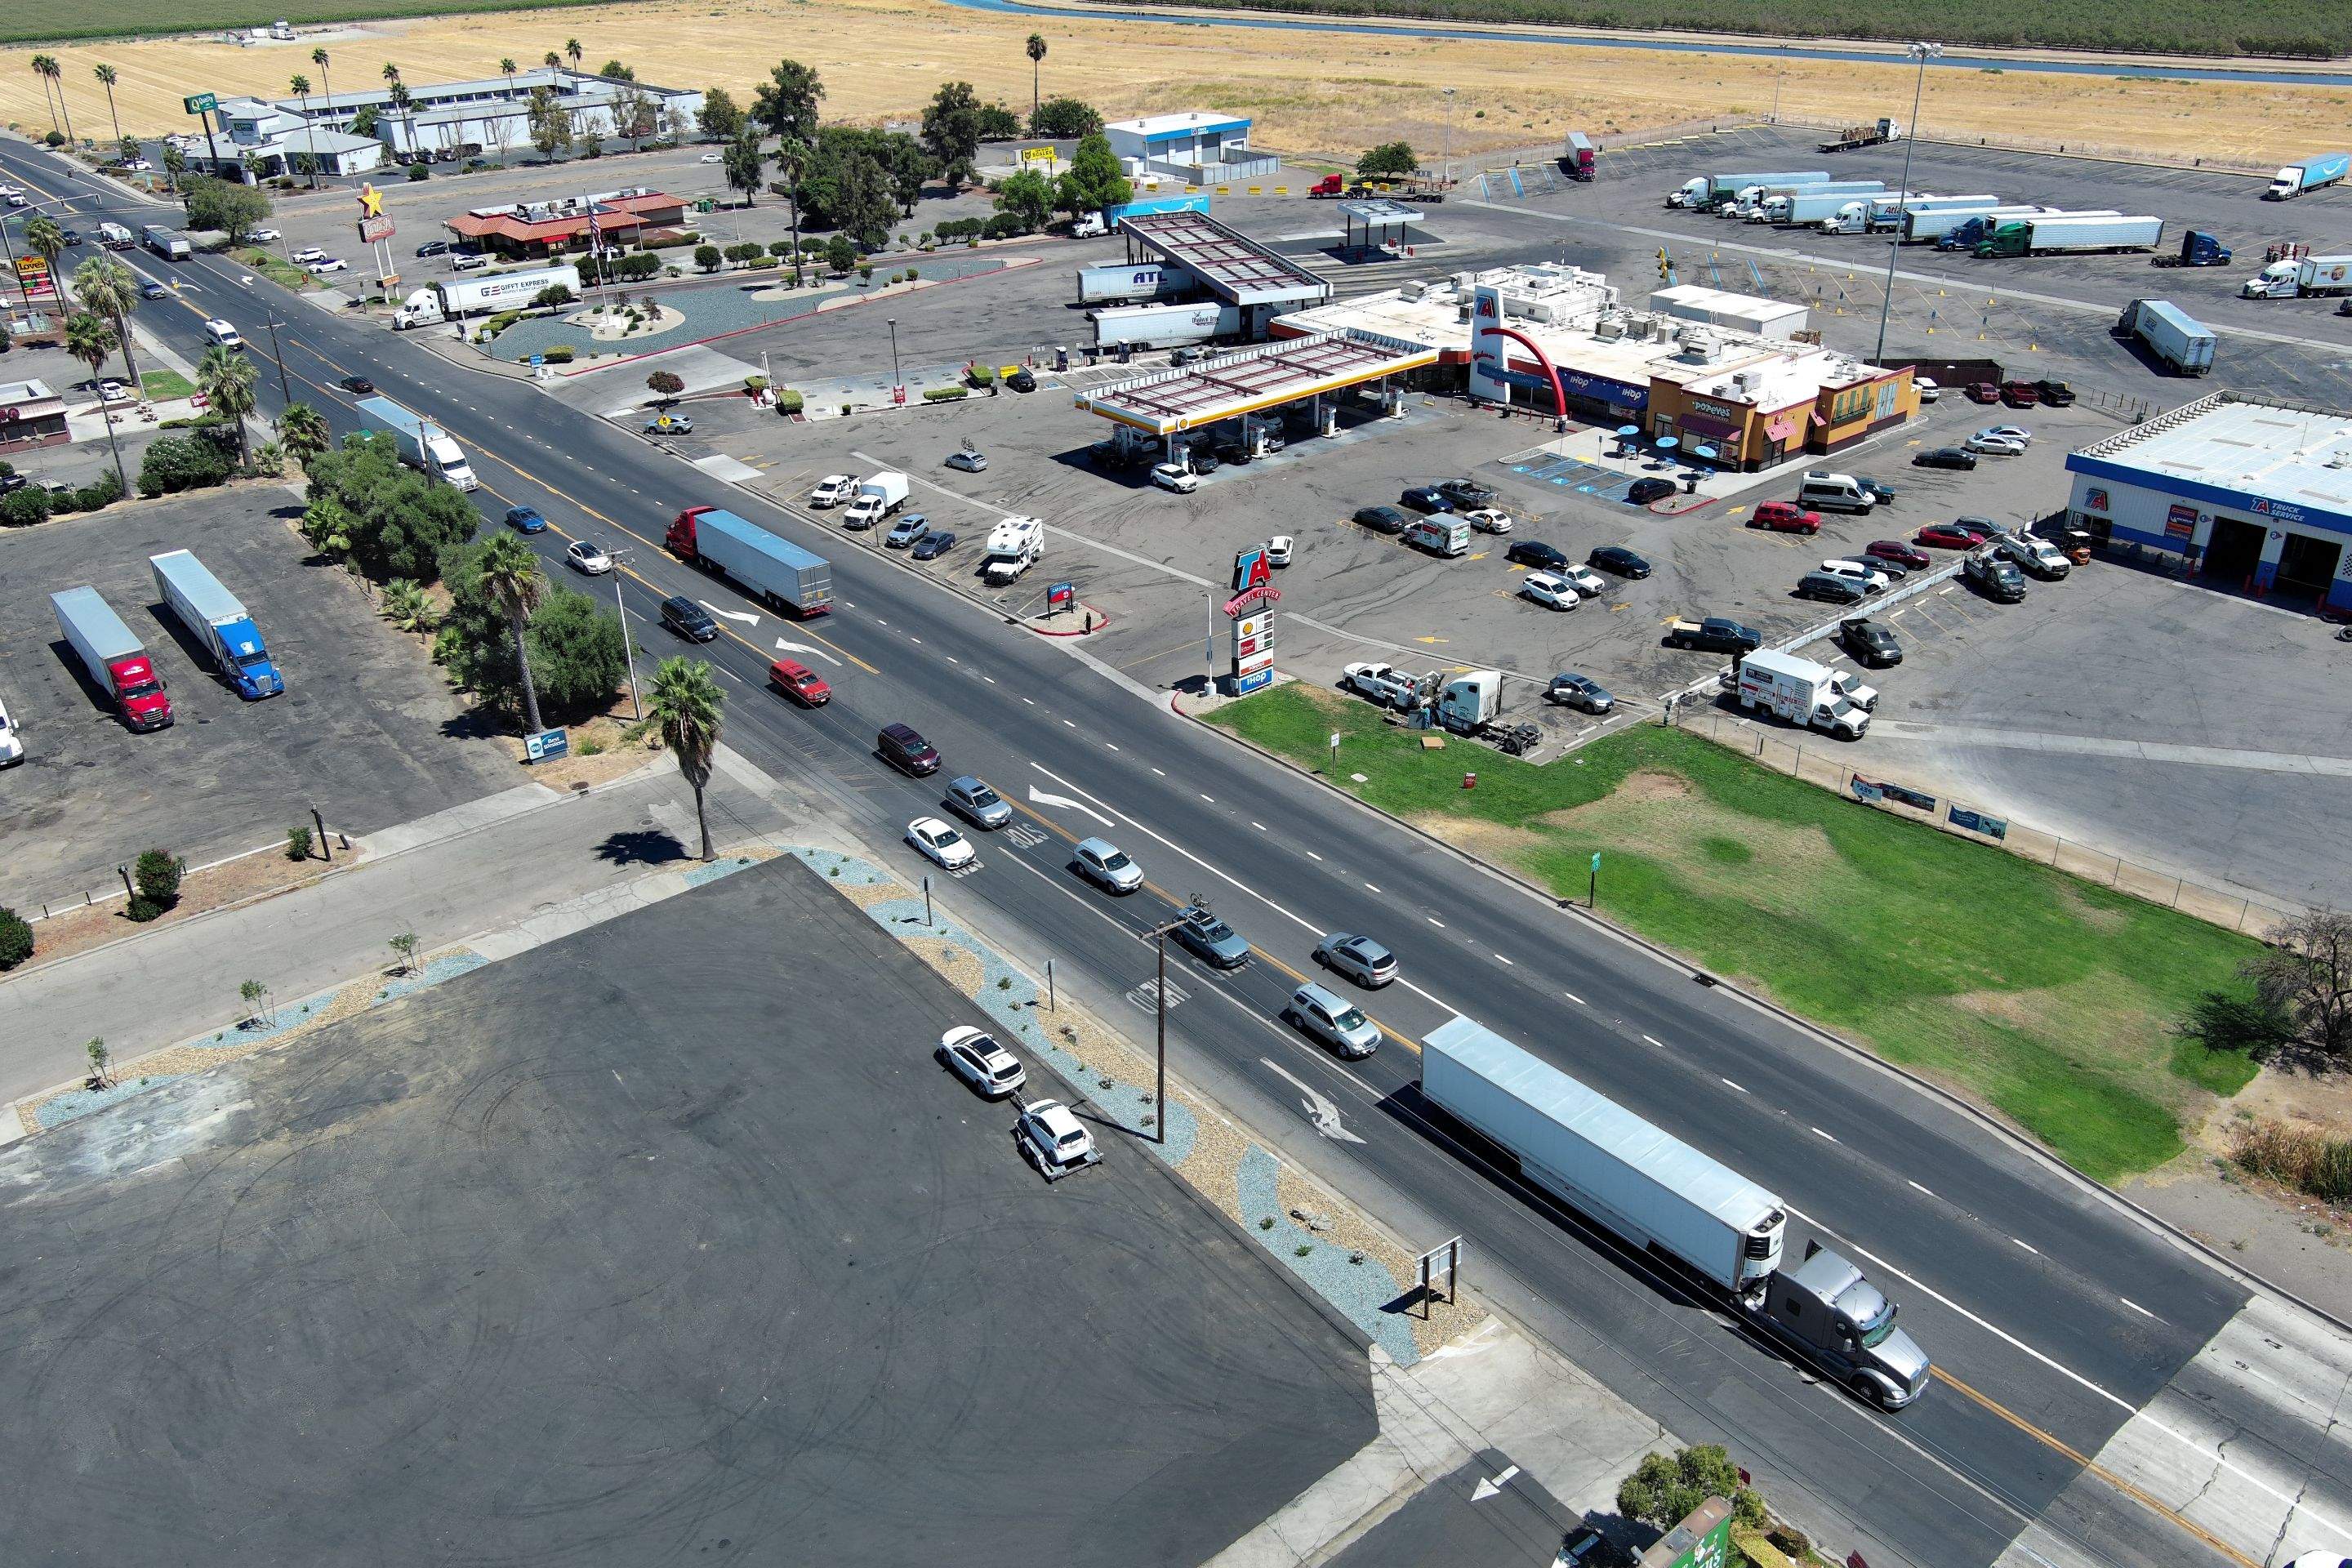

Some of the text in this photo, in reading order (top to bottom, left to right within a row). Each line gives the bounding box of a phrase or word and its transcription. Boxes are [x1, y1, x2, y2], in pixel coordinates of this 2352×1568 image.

[1884, 206, 1908, 214] Atlas
[17, 261, 46, 271] Love's
[1133, 271, 1168, 283] ATL
[501, 283, 519, 291] GIFFT
[520, 278, 550, 287] EXPRESS
[2084, 488, 2107, 511] TA
[2250, 497, 2301, 514] TA TRUCK
[2270, 510, 2305, 522] SERVICE
[1237, 549, 1272, 591] TA
[1232, 590, 1280, 613] TRAVEL CENTER
[1246, 672, 1267, 686] IHOP
[543, 739, 566, 750] Western
[1003, 822, 1049, 849] STOP
[1125, 975, 1192, 1015] AHEAD
